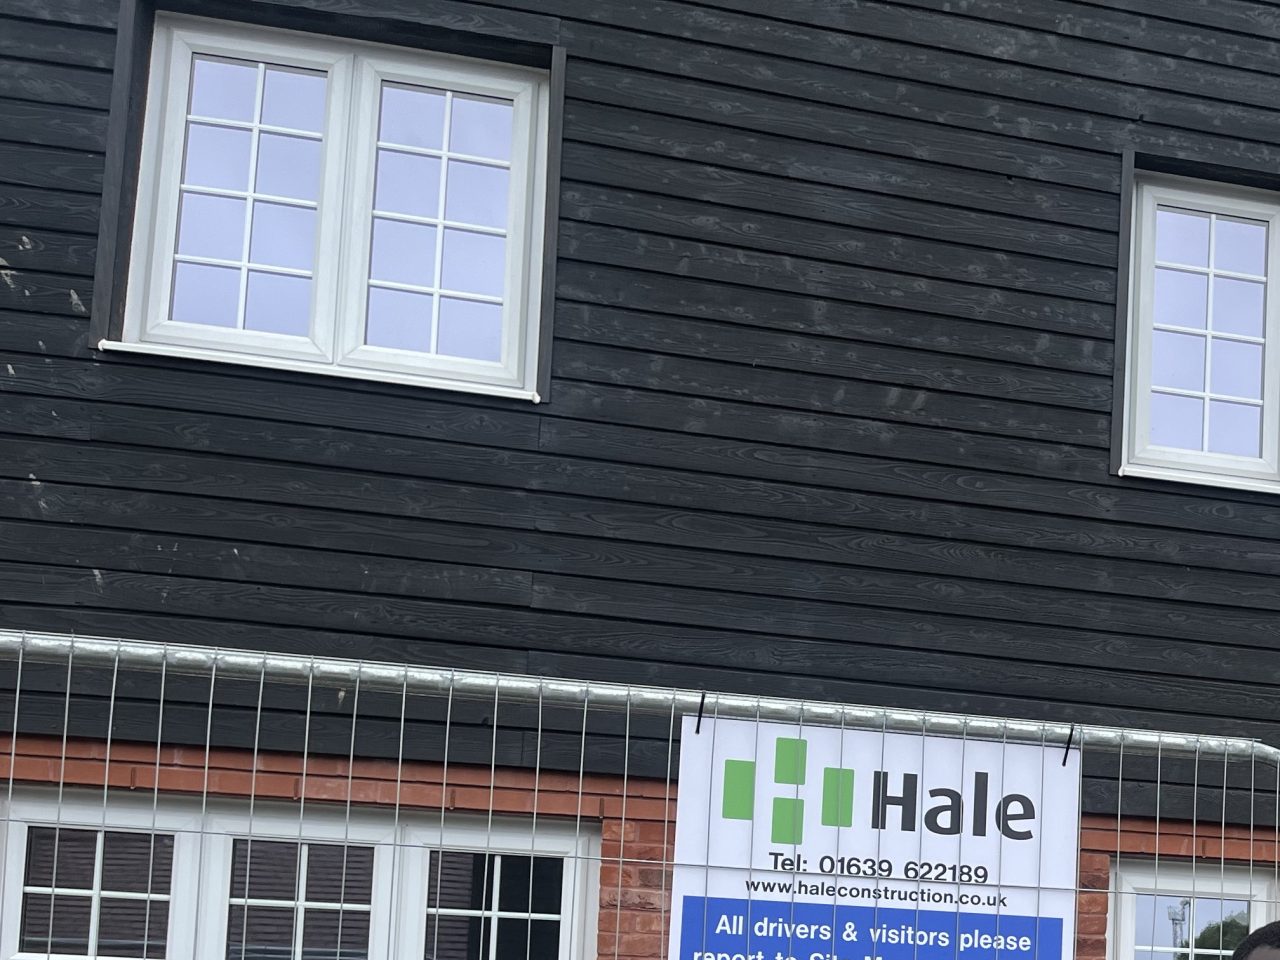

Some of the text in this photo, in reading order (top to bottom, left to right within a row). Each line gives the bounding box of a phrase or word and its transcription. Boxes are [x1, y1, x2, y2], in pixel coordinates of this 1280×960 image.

[871, 771, 1036, 840] Hale
[768, 852, 988, 884] Tel: 01639 622189
[745, 880, 1007, 907] www.haleconstruction.co.uk
[715, 915, 1031, 951] All drivers & visitors please
